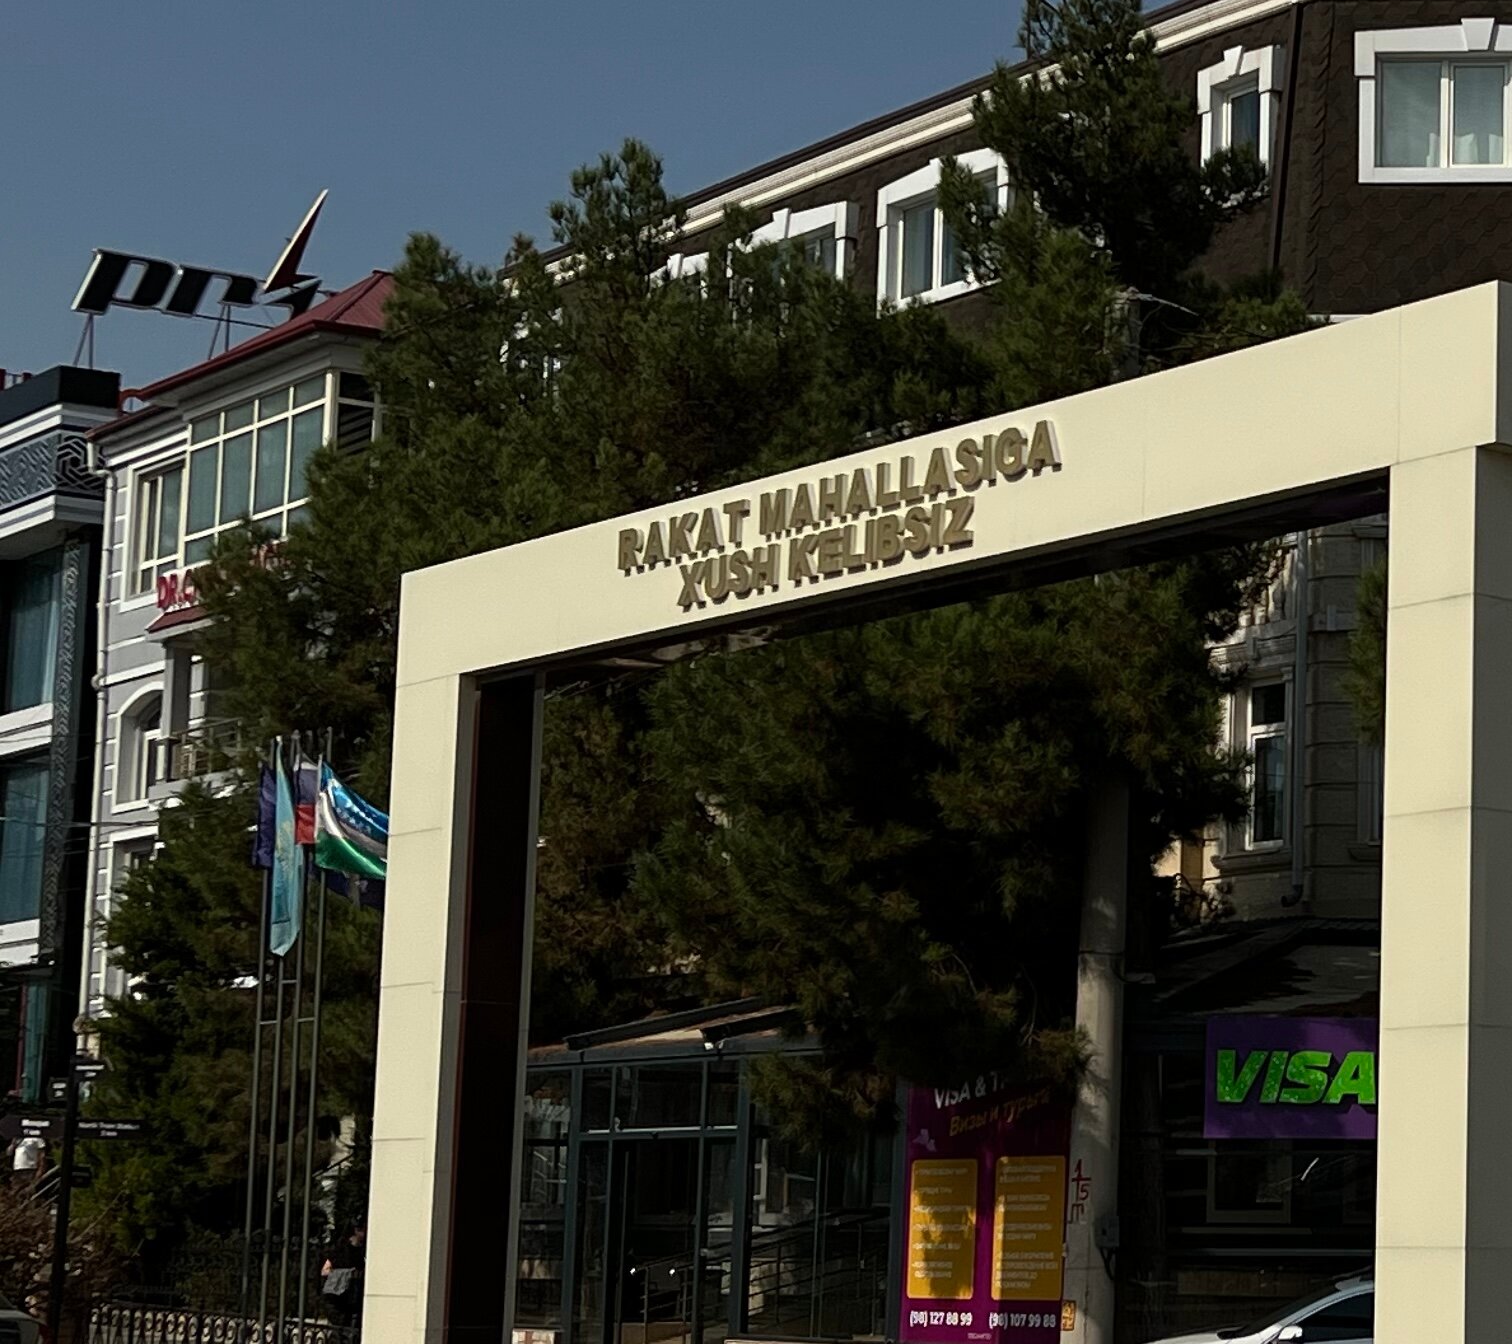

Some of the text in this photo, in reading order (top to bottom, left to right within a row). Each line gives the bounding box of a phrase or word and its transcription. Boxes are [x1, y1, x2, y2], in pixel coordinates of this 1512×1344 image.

[617, 419, 1062, 574] RAKAT MAHALLASIGA
[676, 495, 975, 610] XUSH KELIBSIZ
[933, 1080, 972, 1110] VISA
[974, 1075, 988, 1098] &
[1216, 1048, 1376, 1105] VISA
[948, 1109, 988, 1137] Визы
[929, 1311, 945, 1325] 127
[1028, 1313, 1041, 1328] 99
